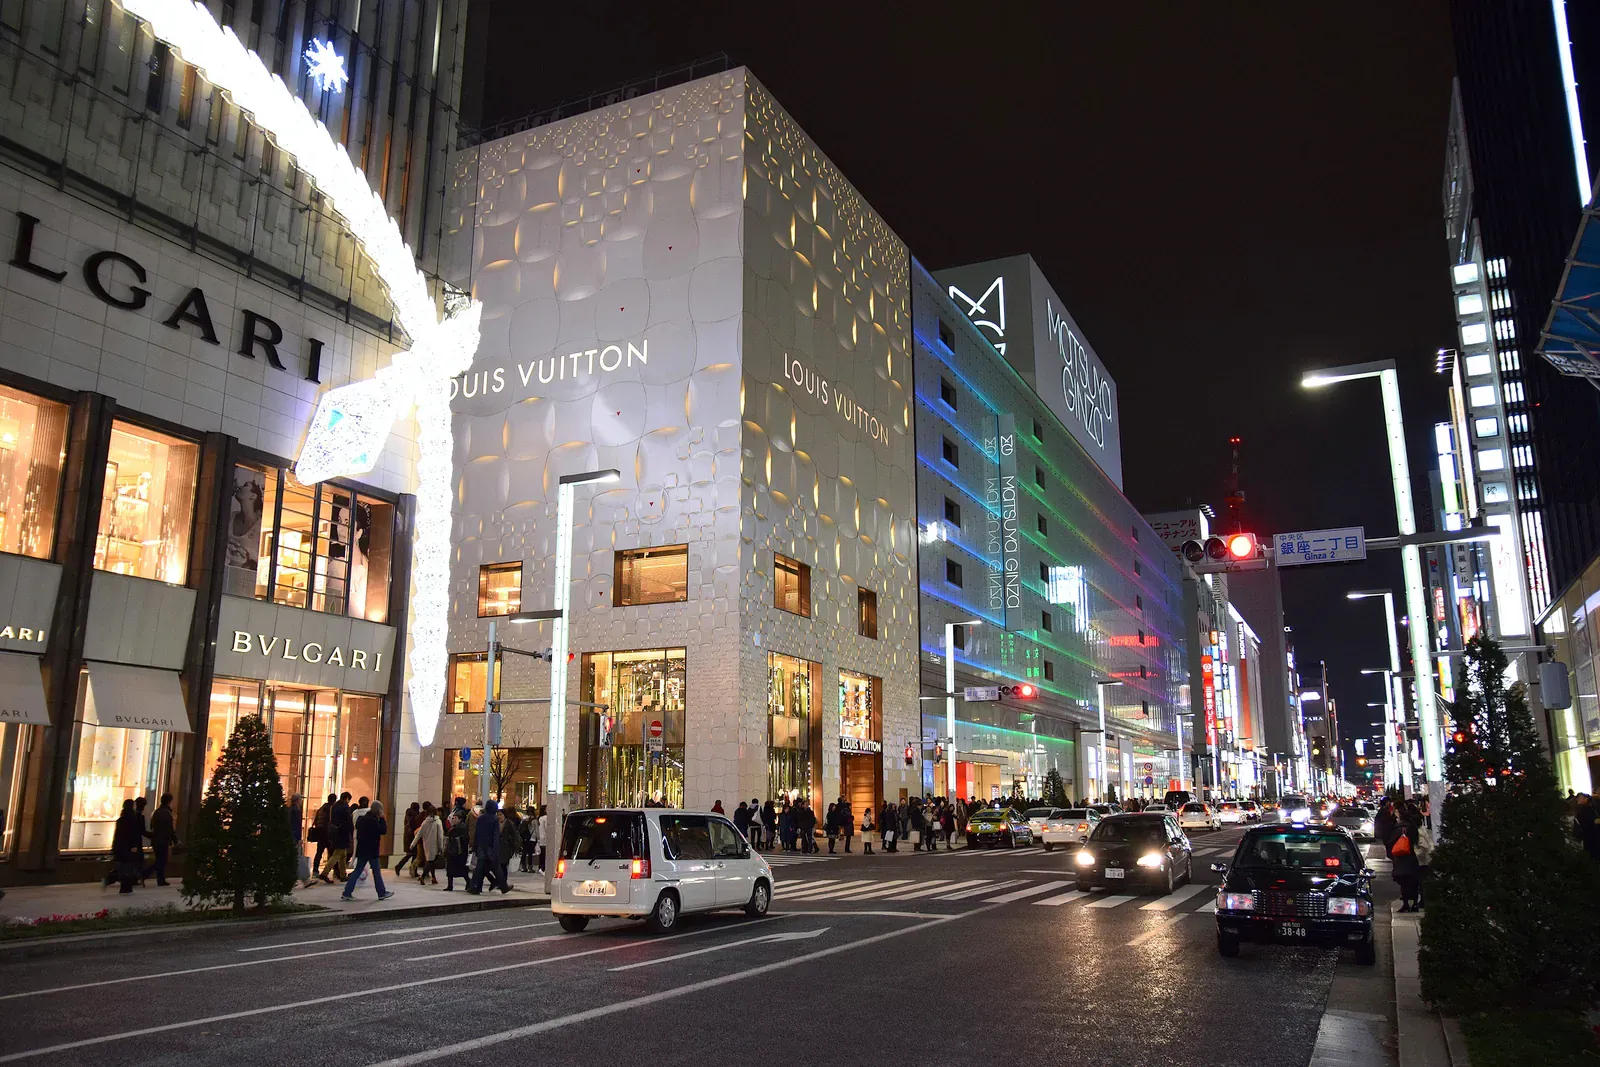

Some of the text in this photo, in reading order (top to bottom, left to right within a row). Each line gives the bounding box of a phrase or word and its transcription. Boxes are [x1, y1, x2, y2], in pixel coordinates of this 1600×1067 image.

[517, 338, 648, 388] VUITTON
[784, 352, 889, 446] LOUIS VUITTON
[1280, 533, 1304, 541] 中央区
[1280, 536, 1359, 555] 銀座二丁目
[1304, 551, 1336, 560] Ginza 2
[231, 630, 383, 672] BVLGARI
[115, 715, 174, 727] BVLGARI
[842, 738, 858, 750] LOUIS
